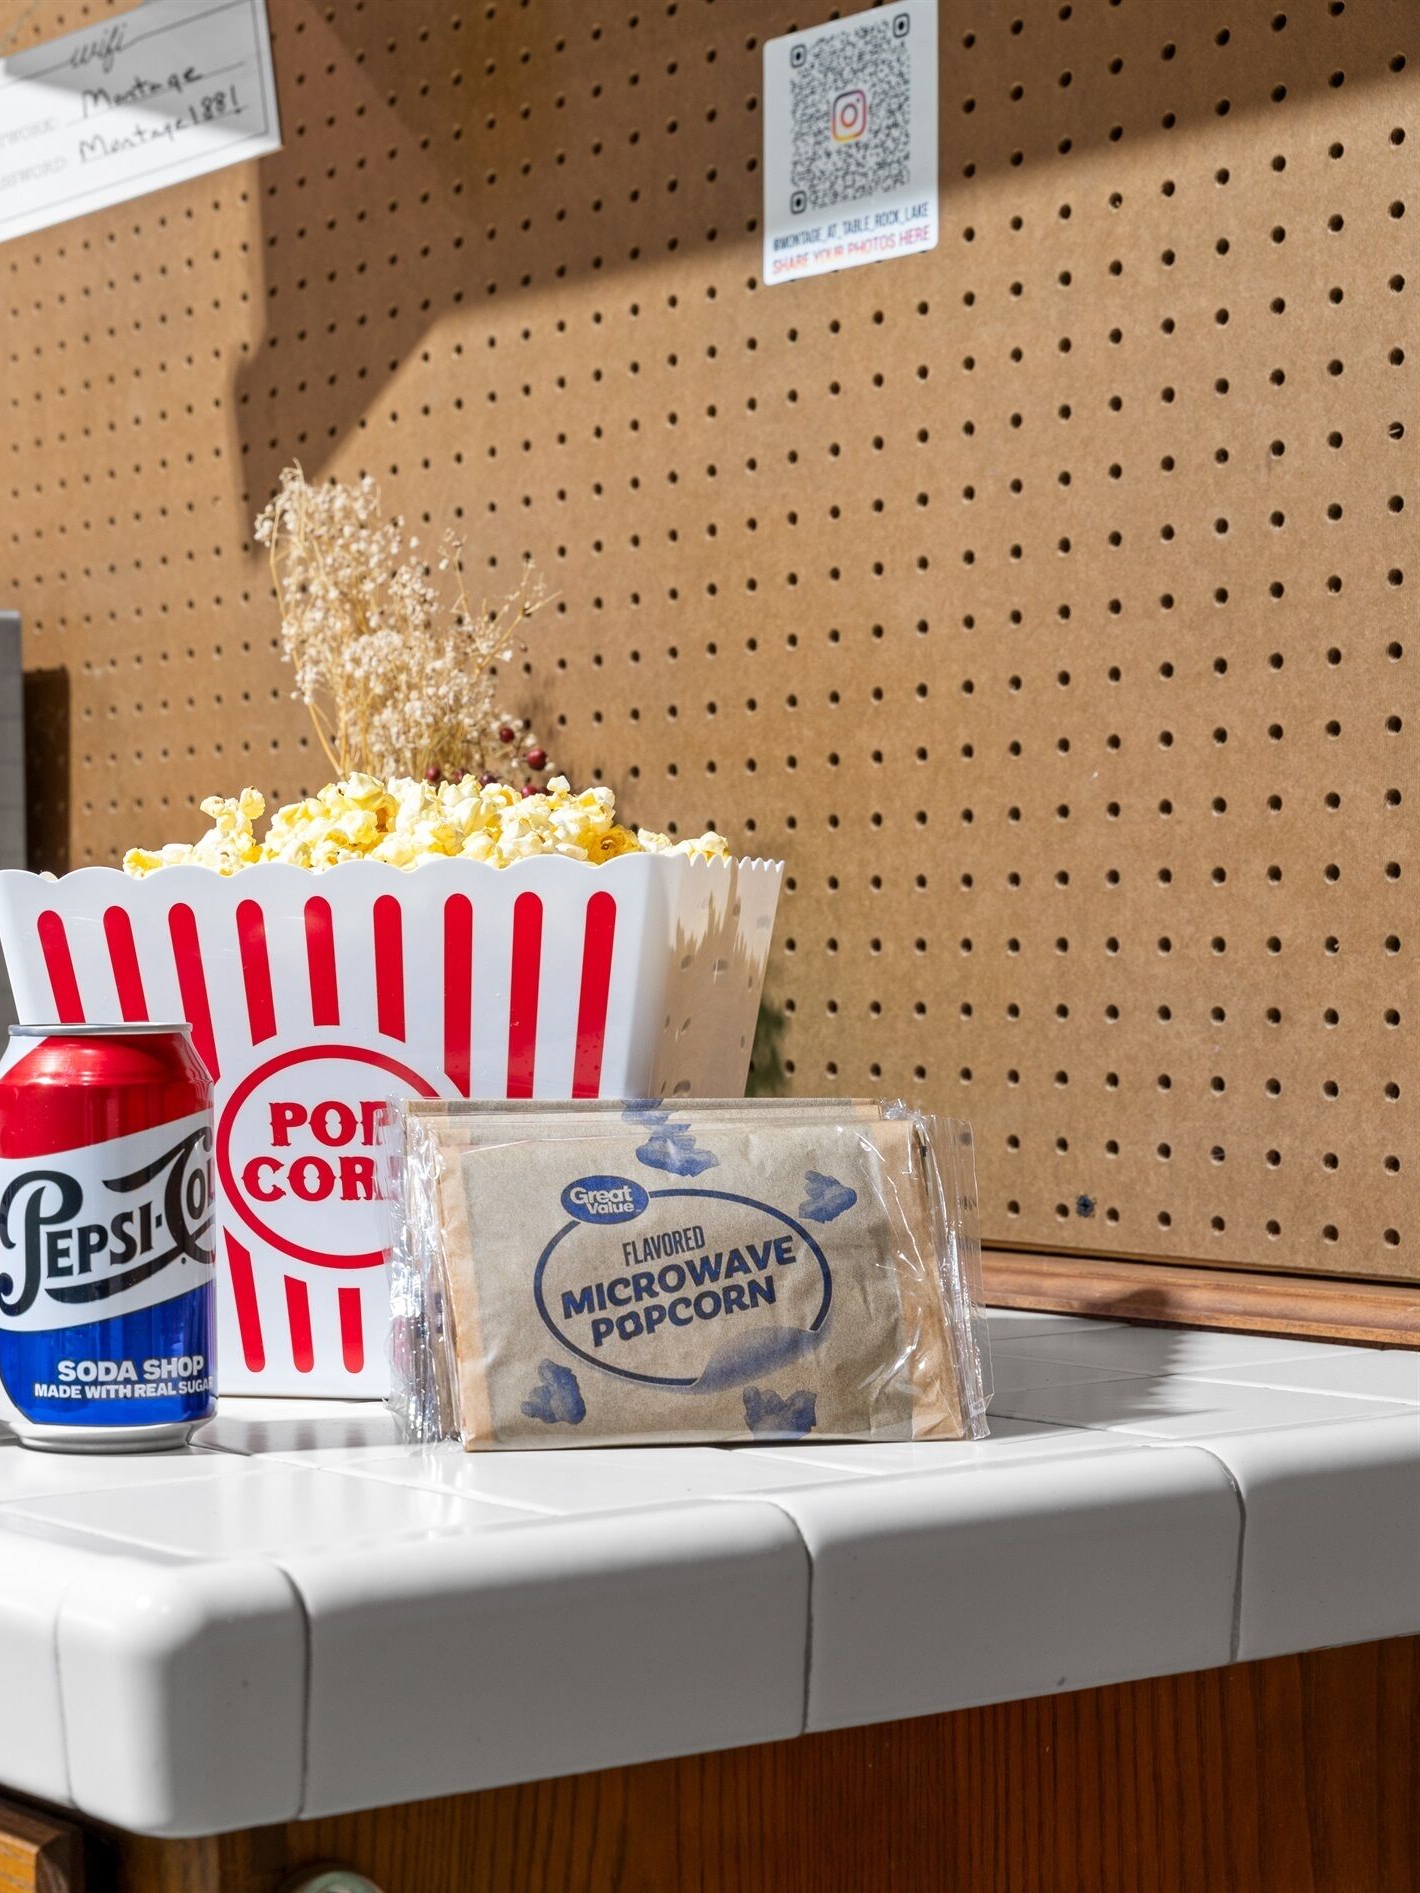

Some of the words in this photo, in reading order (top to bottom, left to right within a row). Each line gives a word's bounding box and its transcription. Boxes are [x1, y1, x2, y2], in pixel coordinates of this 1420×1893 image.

[83, 66, 203, 118] Montage
[899, 224, 930, 246] HERE
[569, 1185, 633, 1205] Great
[586, 1202, 635, 1215] Value
[622, 1225, 706, 1267] FLAVORED
[561, 1235, 797, 1320] MICROWAVE
[591, 1275, 777, 1348] POPCORN
[57, 1360, 139, 1382] SODA
[143, 1355, 204, 1379] SHOP
[34, 1383, 81, 1399] MADE
[84, 1384, 131, 1398] WITH
[134, 1382, 177, 1398] REAL
